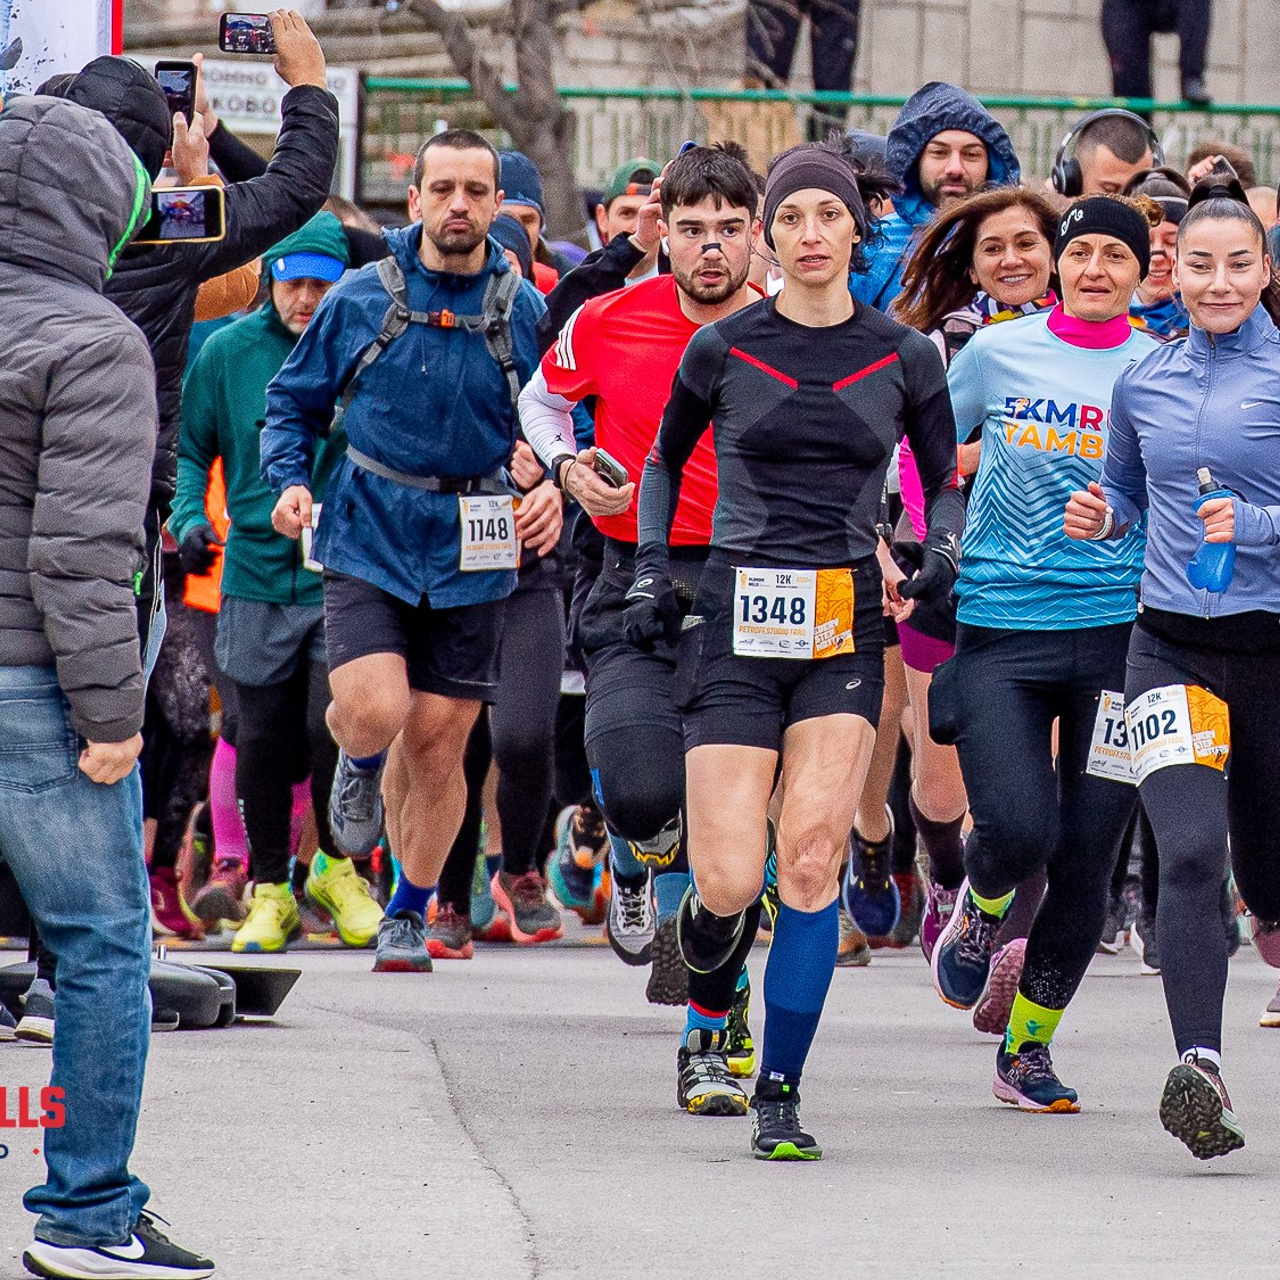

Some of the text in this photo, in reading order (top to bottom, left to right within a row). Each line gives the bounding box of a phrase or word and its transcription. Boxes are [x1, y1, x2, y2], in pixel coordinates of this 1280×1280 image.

[468, 517, 508, 541] 1148
[776, 574, 792, 584] 12K
[740, 595, 806, 625] 1348
[1147, 692, 1161, 704] 12K
[1131, 709, 1178, 751] 1102
